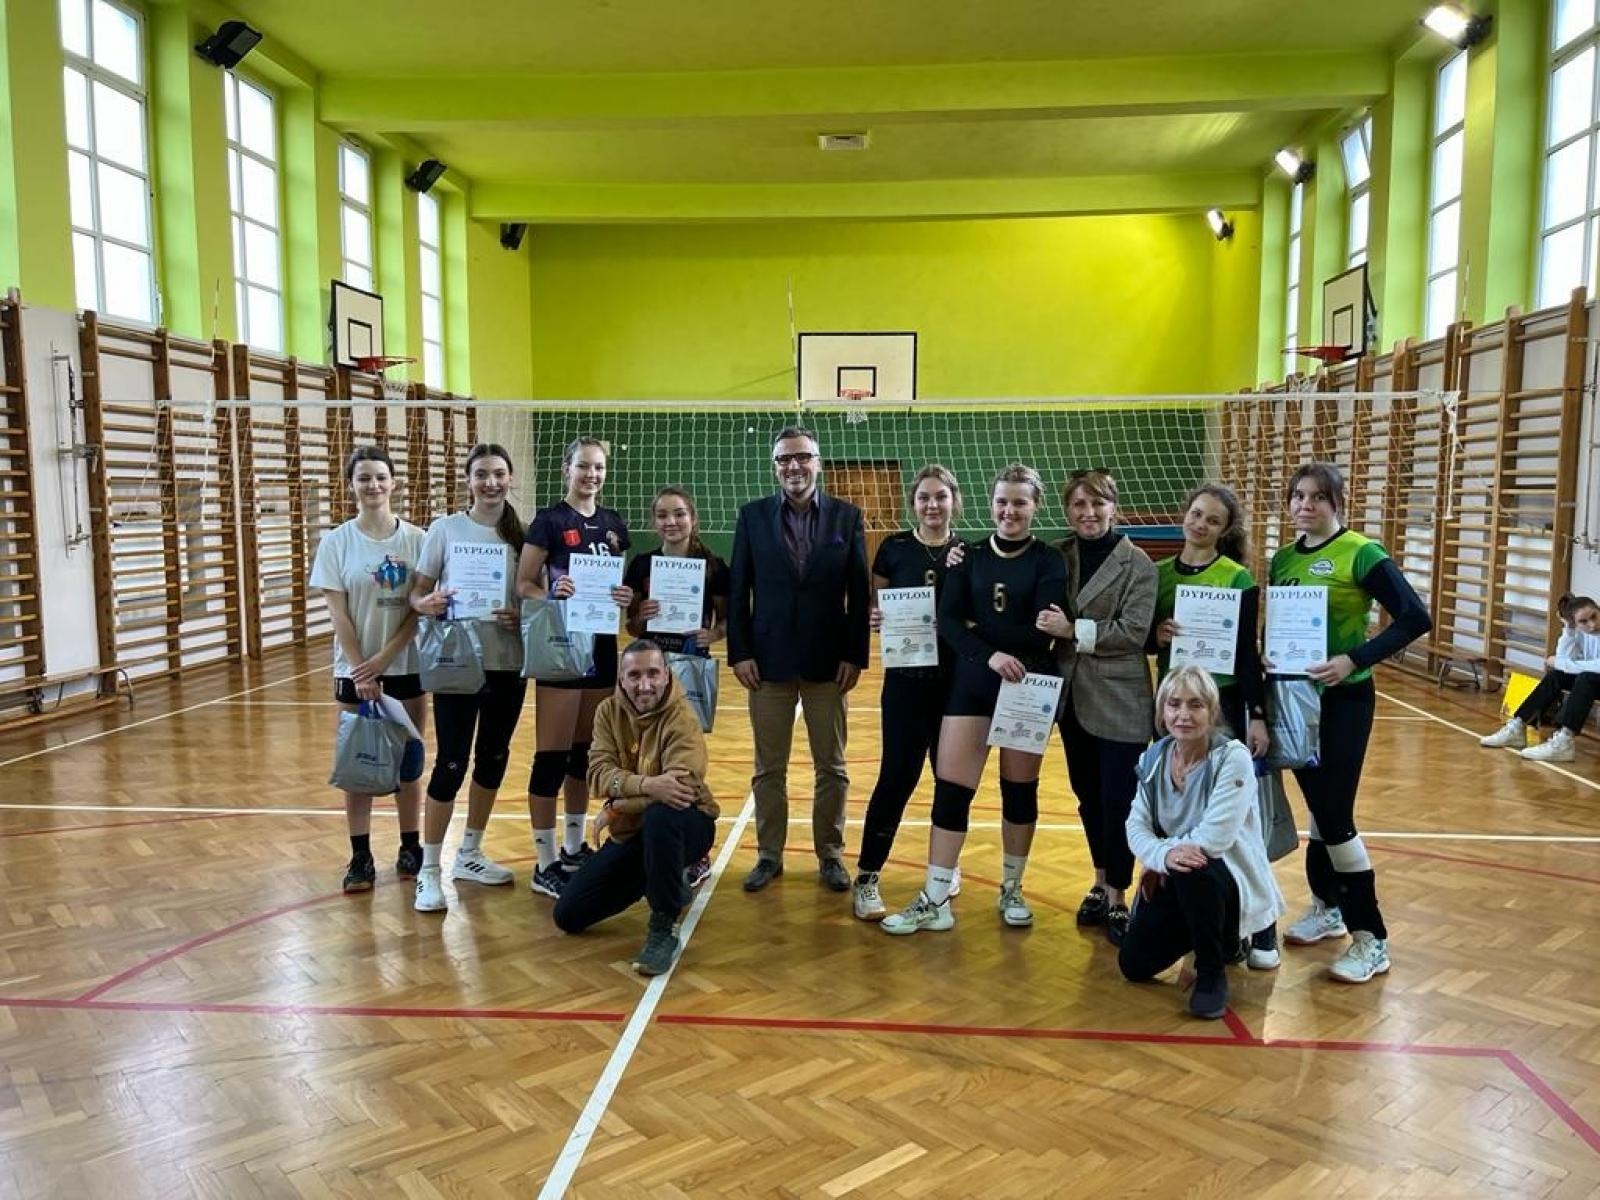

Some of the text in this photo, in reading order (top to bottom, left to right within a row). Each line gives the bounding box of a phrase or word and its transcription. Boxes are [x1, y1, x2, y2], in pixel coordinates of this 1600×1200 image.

[454, 546, 503, 556] DYPLOM
[588, 542, 611, 557] 16
[574, 558, 621, 568] DYPLOM
[655, 560, 703, 570] DYPLOM
[882, 591, 931, 601] DYPLOM
[994, 582, 1006, 612] 5
[1180, 588, 1237, 602] DYPLOM
[1270, 590, 1323, 600] DYPLOM
[1024, 677, 1058, 688] PLOM
